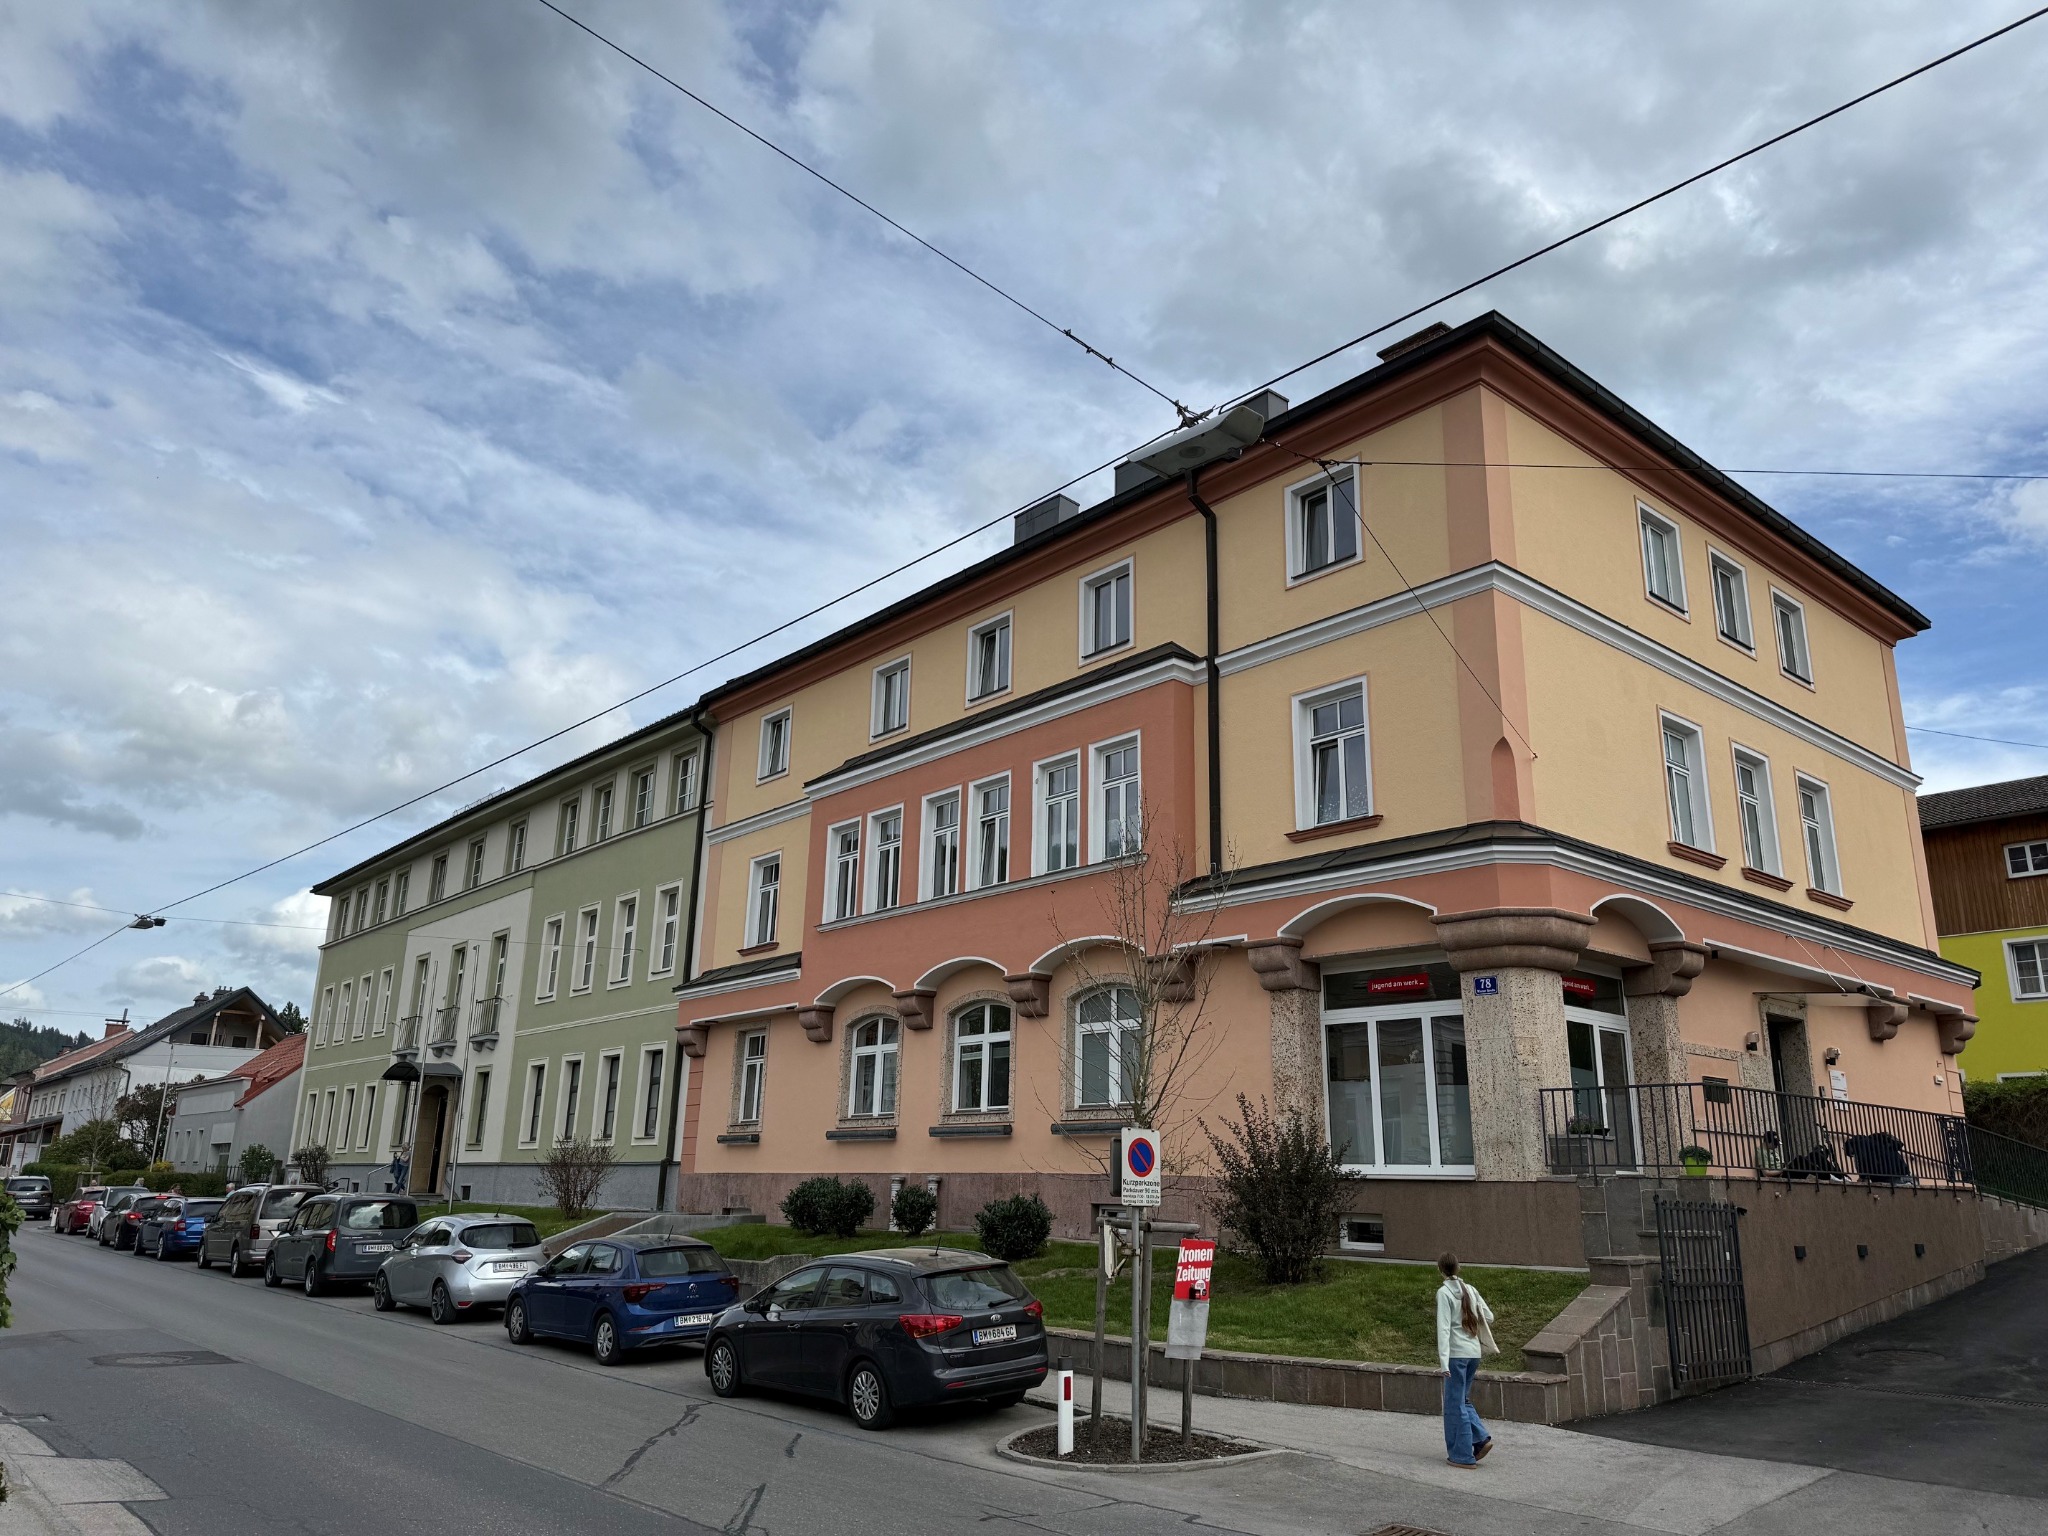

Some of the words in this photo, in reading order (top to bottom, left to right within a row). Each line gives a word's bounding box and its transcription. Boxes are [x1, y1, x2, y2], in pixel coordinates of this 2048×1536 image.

[1372, 982, 1392, 990] jugend
[1480, 978, 1491, 988] 78
[1123, 1178, 1160, 1188] Kurzparkzone
[1178, 1247, 1213, 1263] Kronen
[1177, 1265, 1211, 1281] Zeitung
[979, 1330, 989, 1340] BM
[992, 1328, 1004, 1338] 684
[1005, 1326, 1014, 1336] GC
